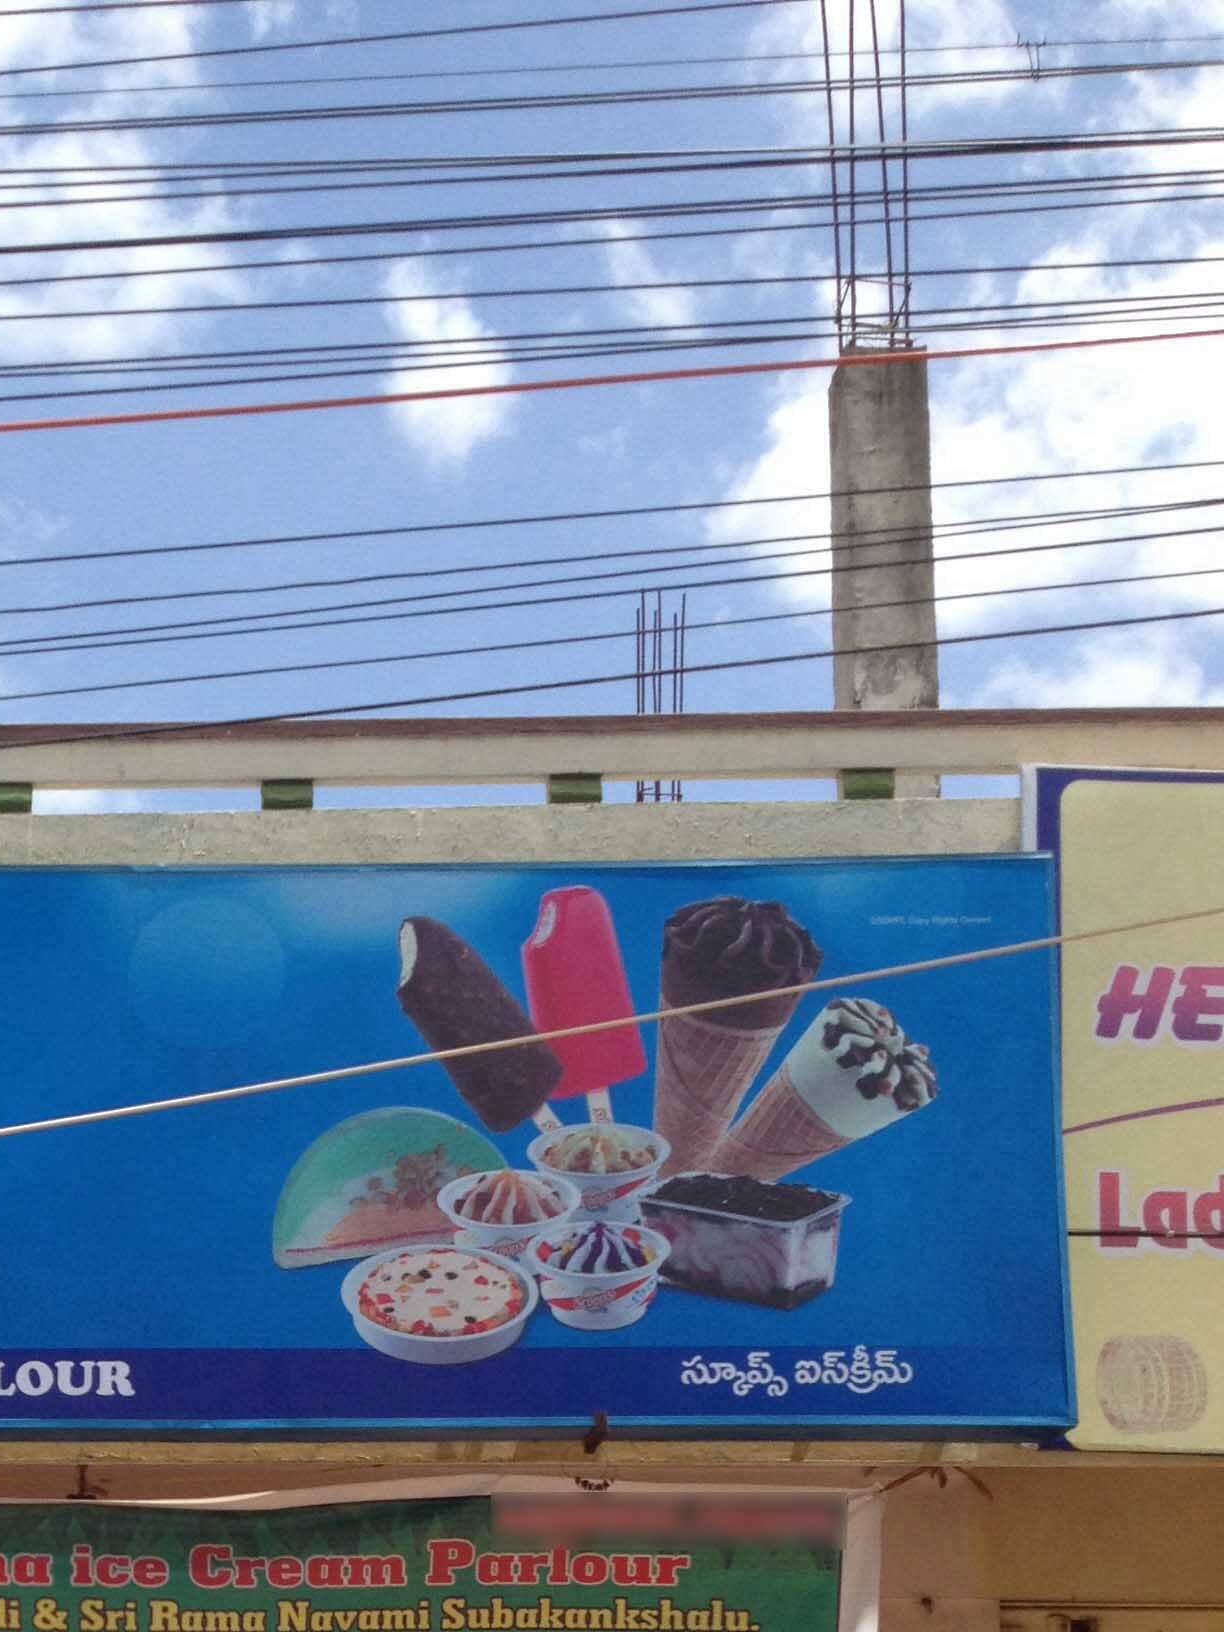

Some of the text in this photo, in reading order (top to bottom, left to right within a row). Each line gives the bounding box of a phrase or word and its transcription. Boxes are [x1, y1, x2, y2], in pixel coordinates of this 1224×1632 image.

[72, 1545, 168, 1587] ice
[189, 1544, 406, 1588] Cream
[426, 1539, 690, 1586] Parlour
[32, 1597, 69, 1631] &
[79, 1598, 138, 1632] Sri
[440, 1597, 761, 1632] Subakankshalu.
